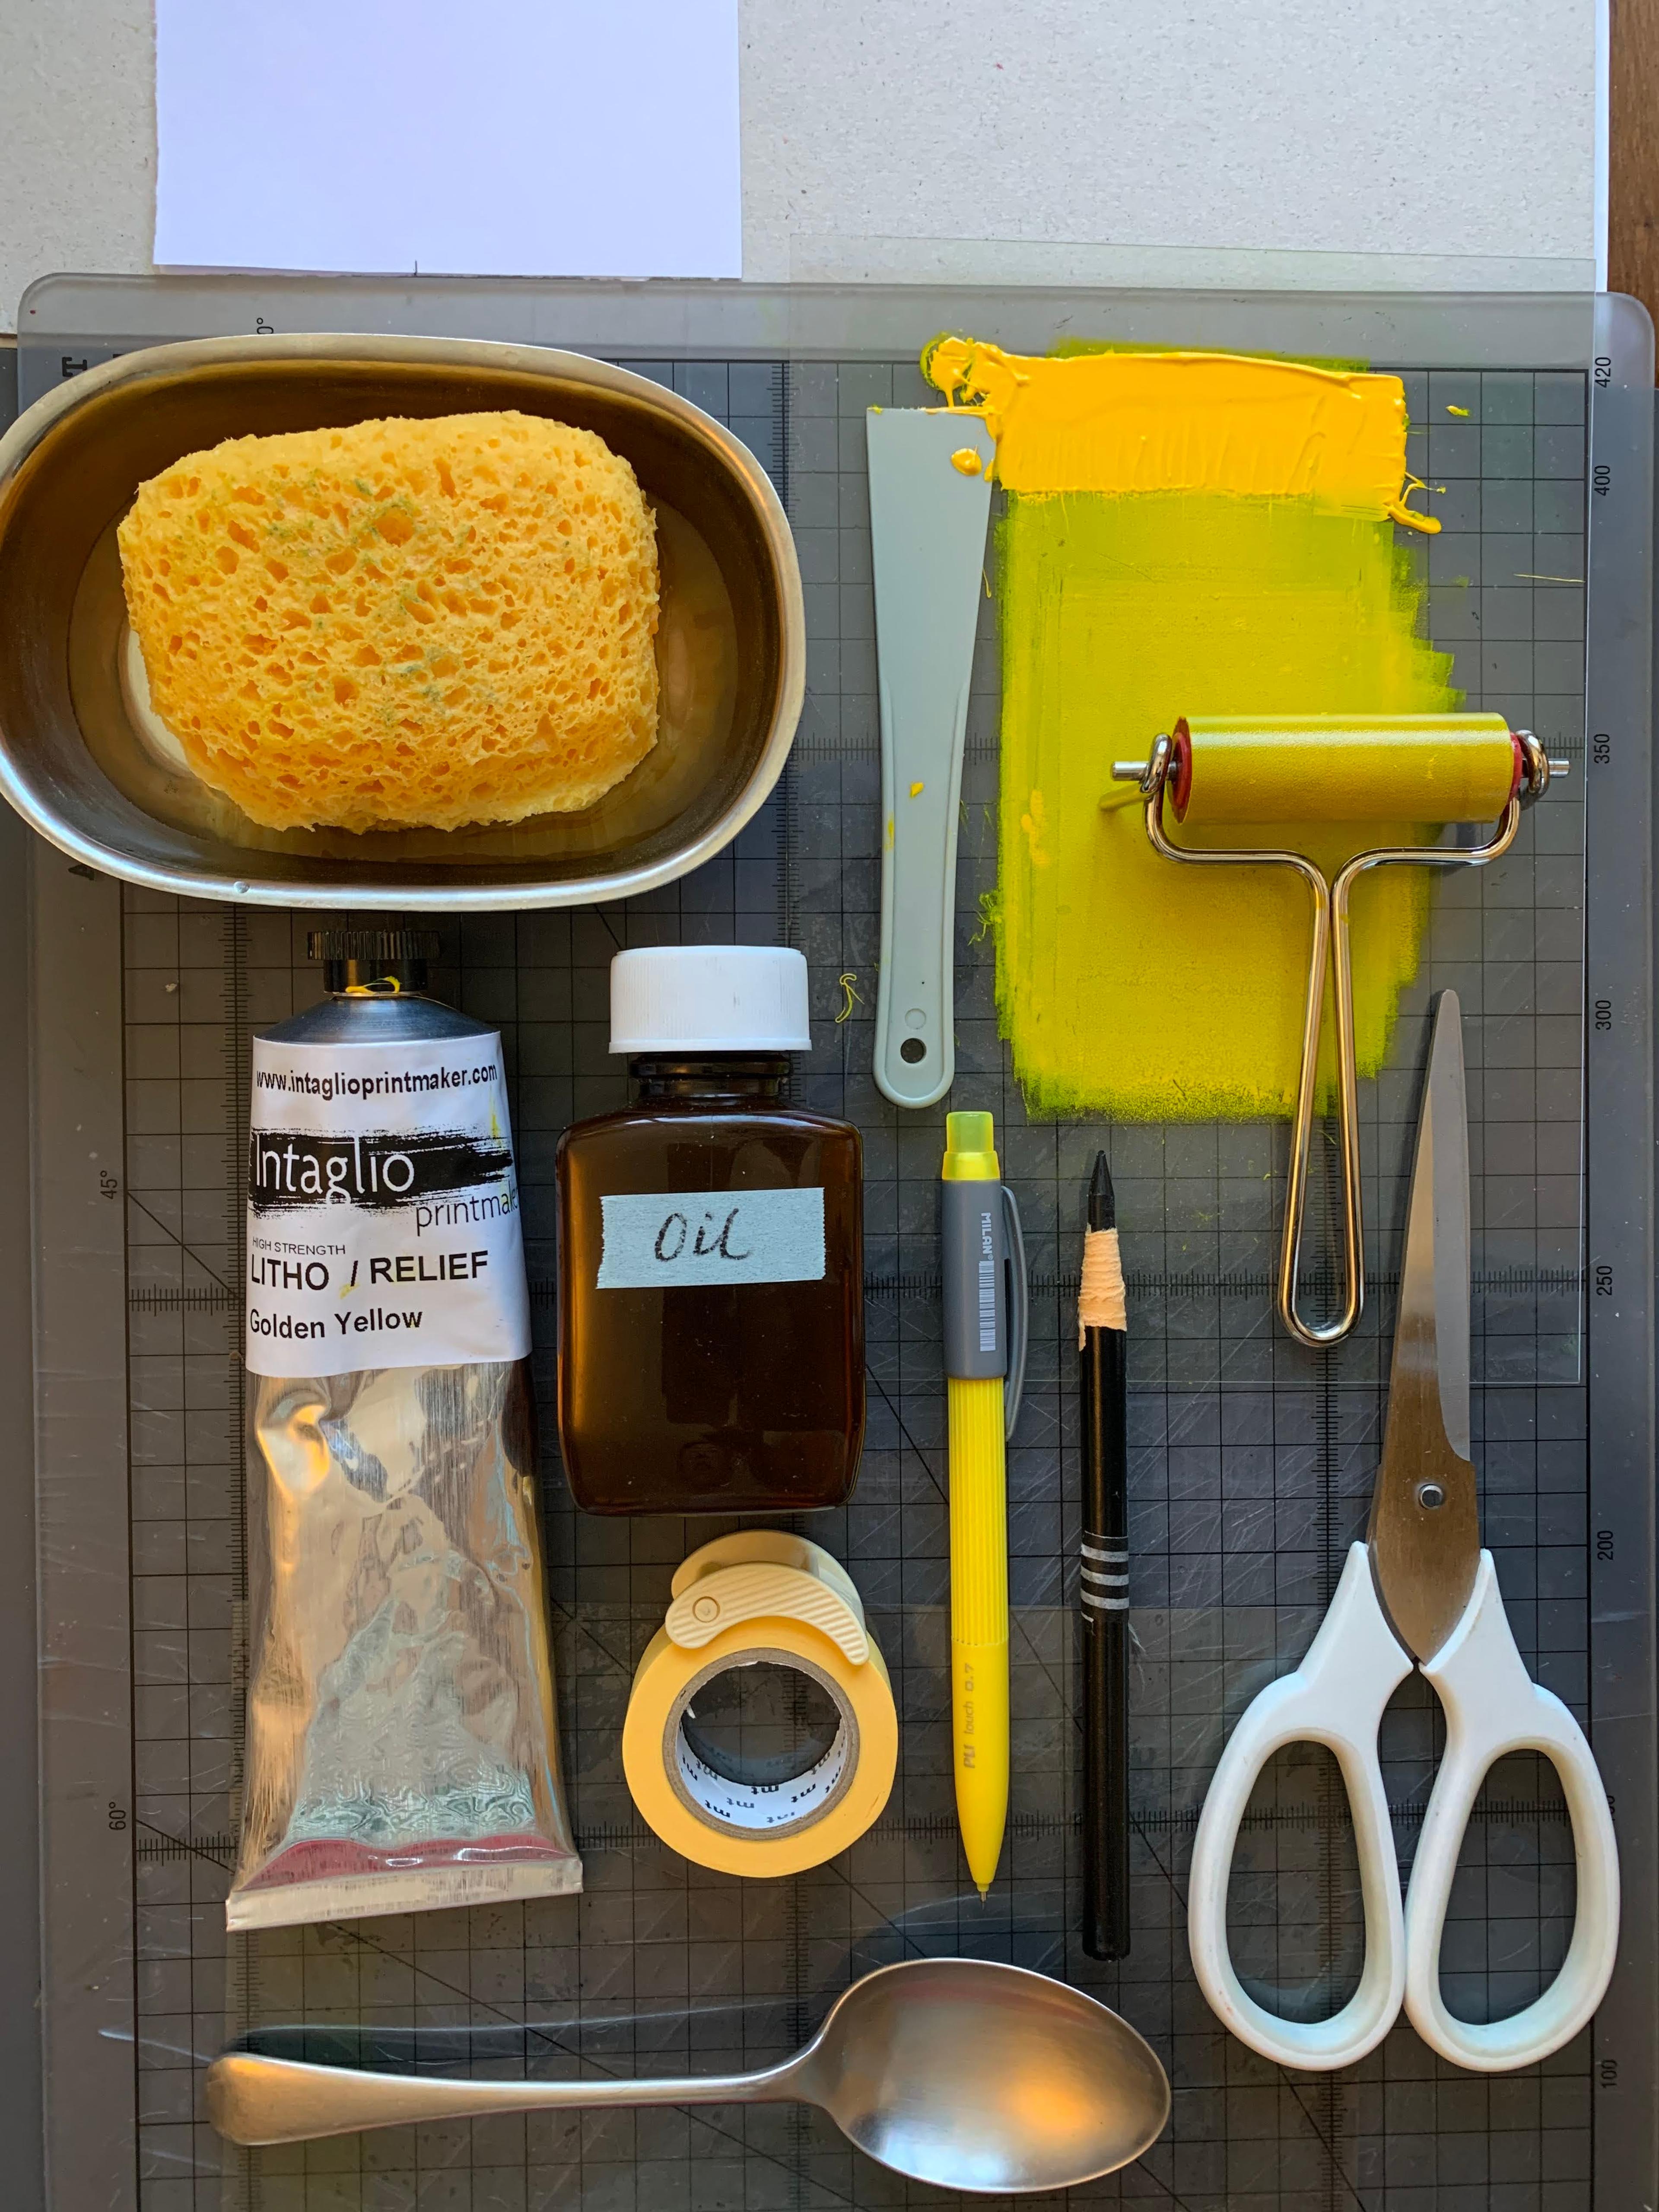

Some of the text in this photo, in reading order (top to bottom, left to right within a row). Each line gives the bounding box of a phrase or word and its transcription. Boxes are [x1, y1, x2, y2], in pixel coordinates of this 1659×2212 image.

[1595, 357, 1611, 388] 420
[1594, 465, 1611, 496] 400
[1595, 733, 1611, 764] 350
[1595, 999, 1612, 1030] 300
[257, 1065, 497, 1100] www.intaglioprintmaker.com
[100, 1170, 118, 1200] 45°
[256, 1134, 415, 1208] Intaglio
[416, 1181, 518, 1236] printmake
[252, 1236, 346, 1255] HIGH STRENGTH
[252, 1250, 488, 1290] LITHO / RELIEF
[1597, 1265, 1613, 1297] 250
[250, 1308, 423, 1339] Golden Yellow
[1598, 1529, 1615, 1561] 200
[727, 1797, 755, 1808] mt
[751, 1785, 779, 1795] mt
[791, 1783, 816, 1803] mt
[109, 1802, 126, 1831] 60°
[705, 1800, 731, 1818] mt
[1602, 2059, 1617, 2089] 100
